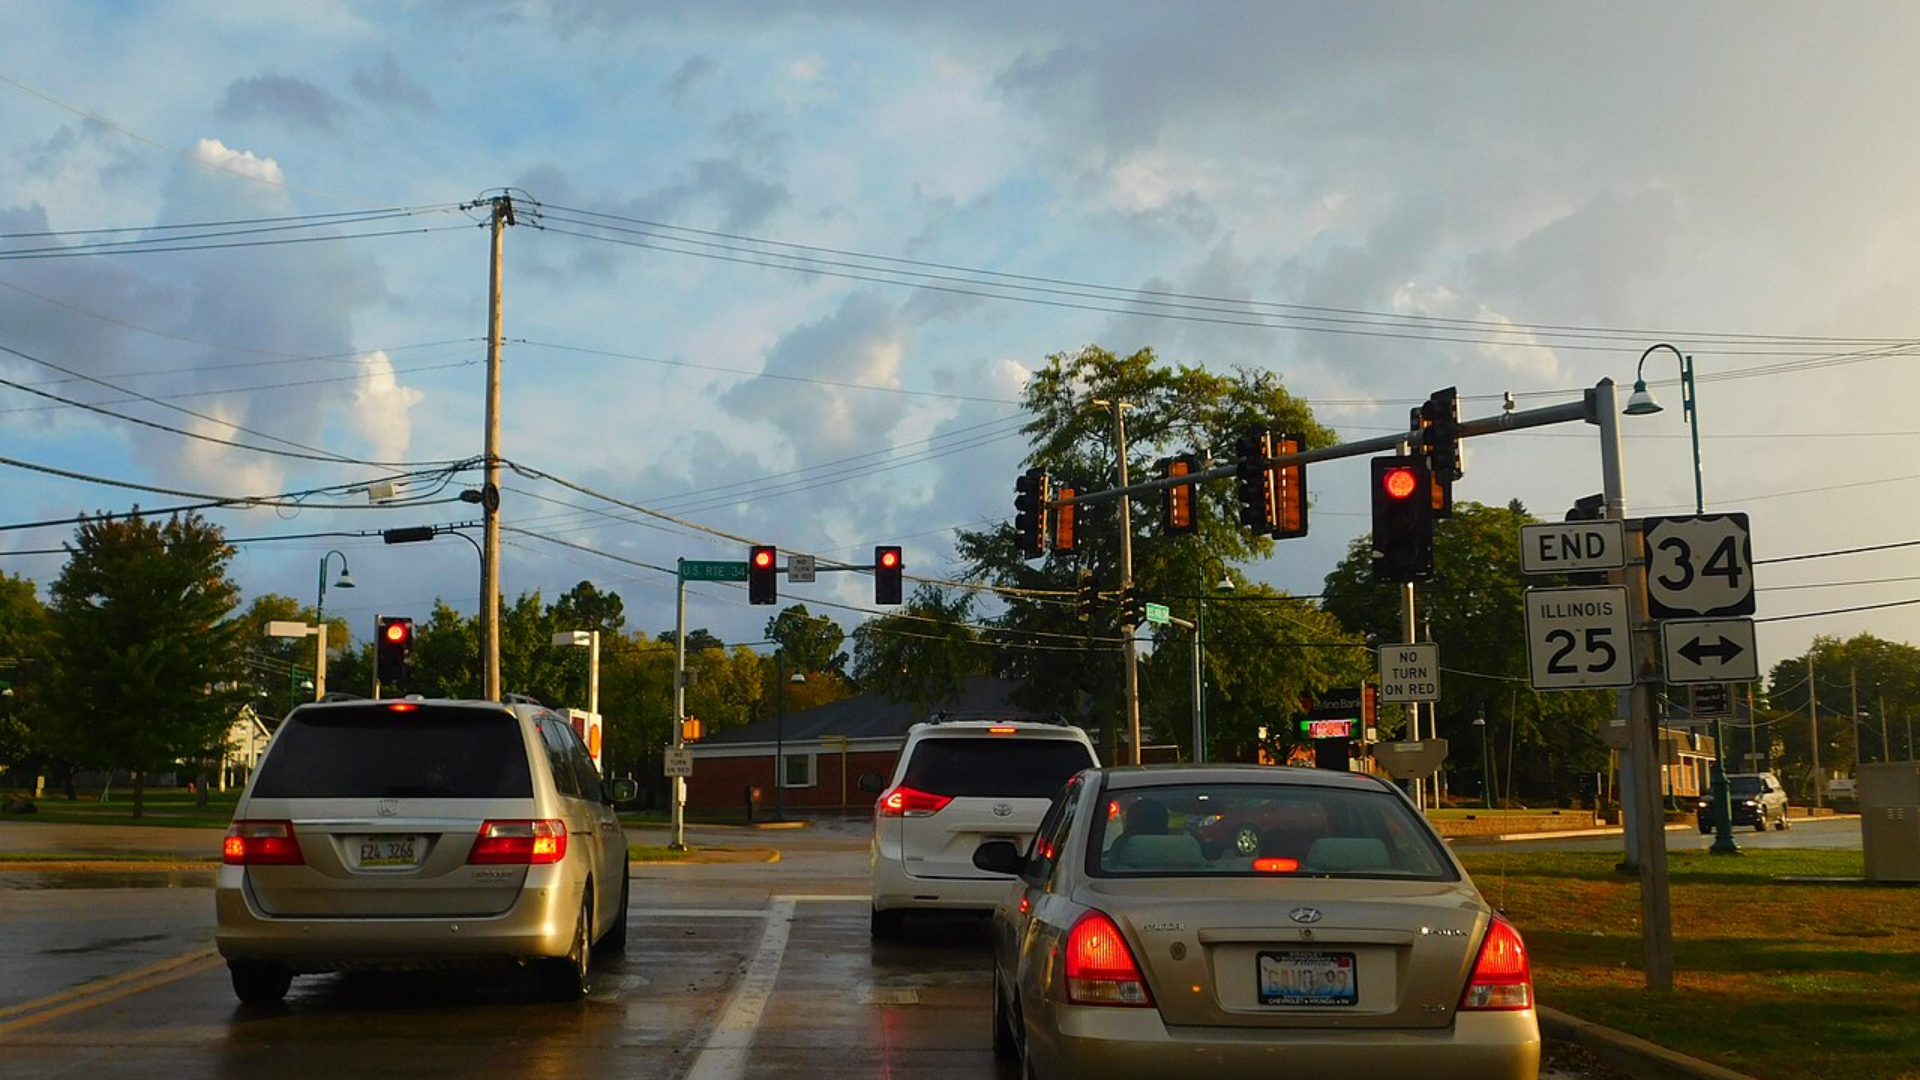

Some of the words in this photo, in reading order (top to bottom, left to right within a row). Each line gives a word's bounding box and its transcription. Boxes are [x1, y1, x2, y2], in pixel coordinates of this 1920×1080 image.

[1539, 532, 1605, 562] END
[1657, 535, 1743, 591] 34
[705, 566, 725, 577] RTE
[731, 566, 745, 577] 34
[1541, 602, 1613, 619] ILLINOIS
[1399, 651, 1418, 662] NO
[1545, 627, 1617, 674] 25
[1392, 667, 1427, 679] TURN
[1385, 684, 1403, 695] ON
[1409, 683, 1435, 695] RED
